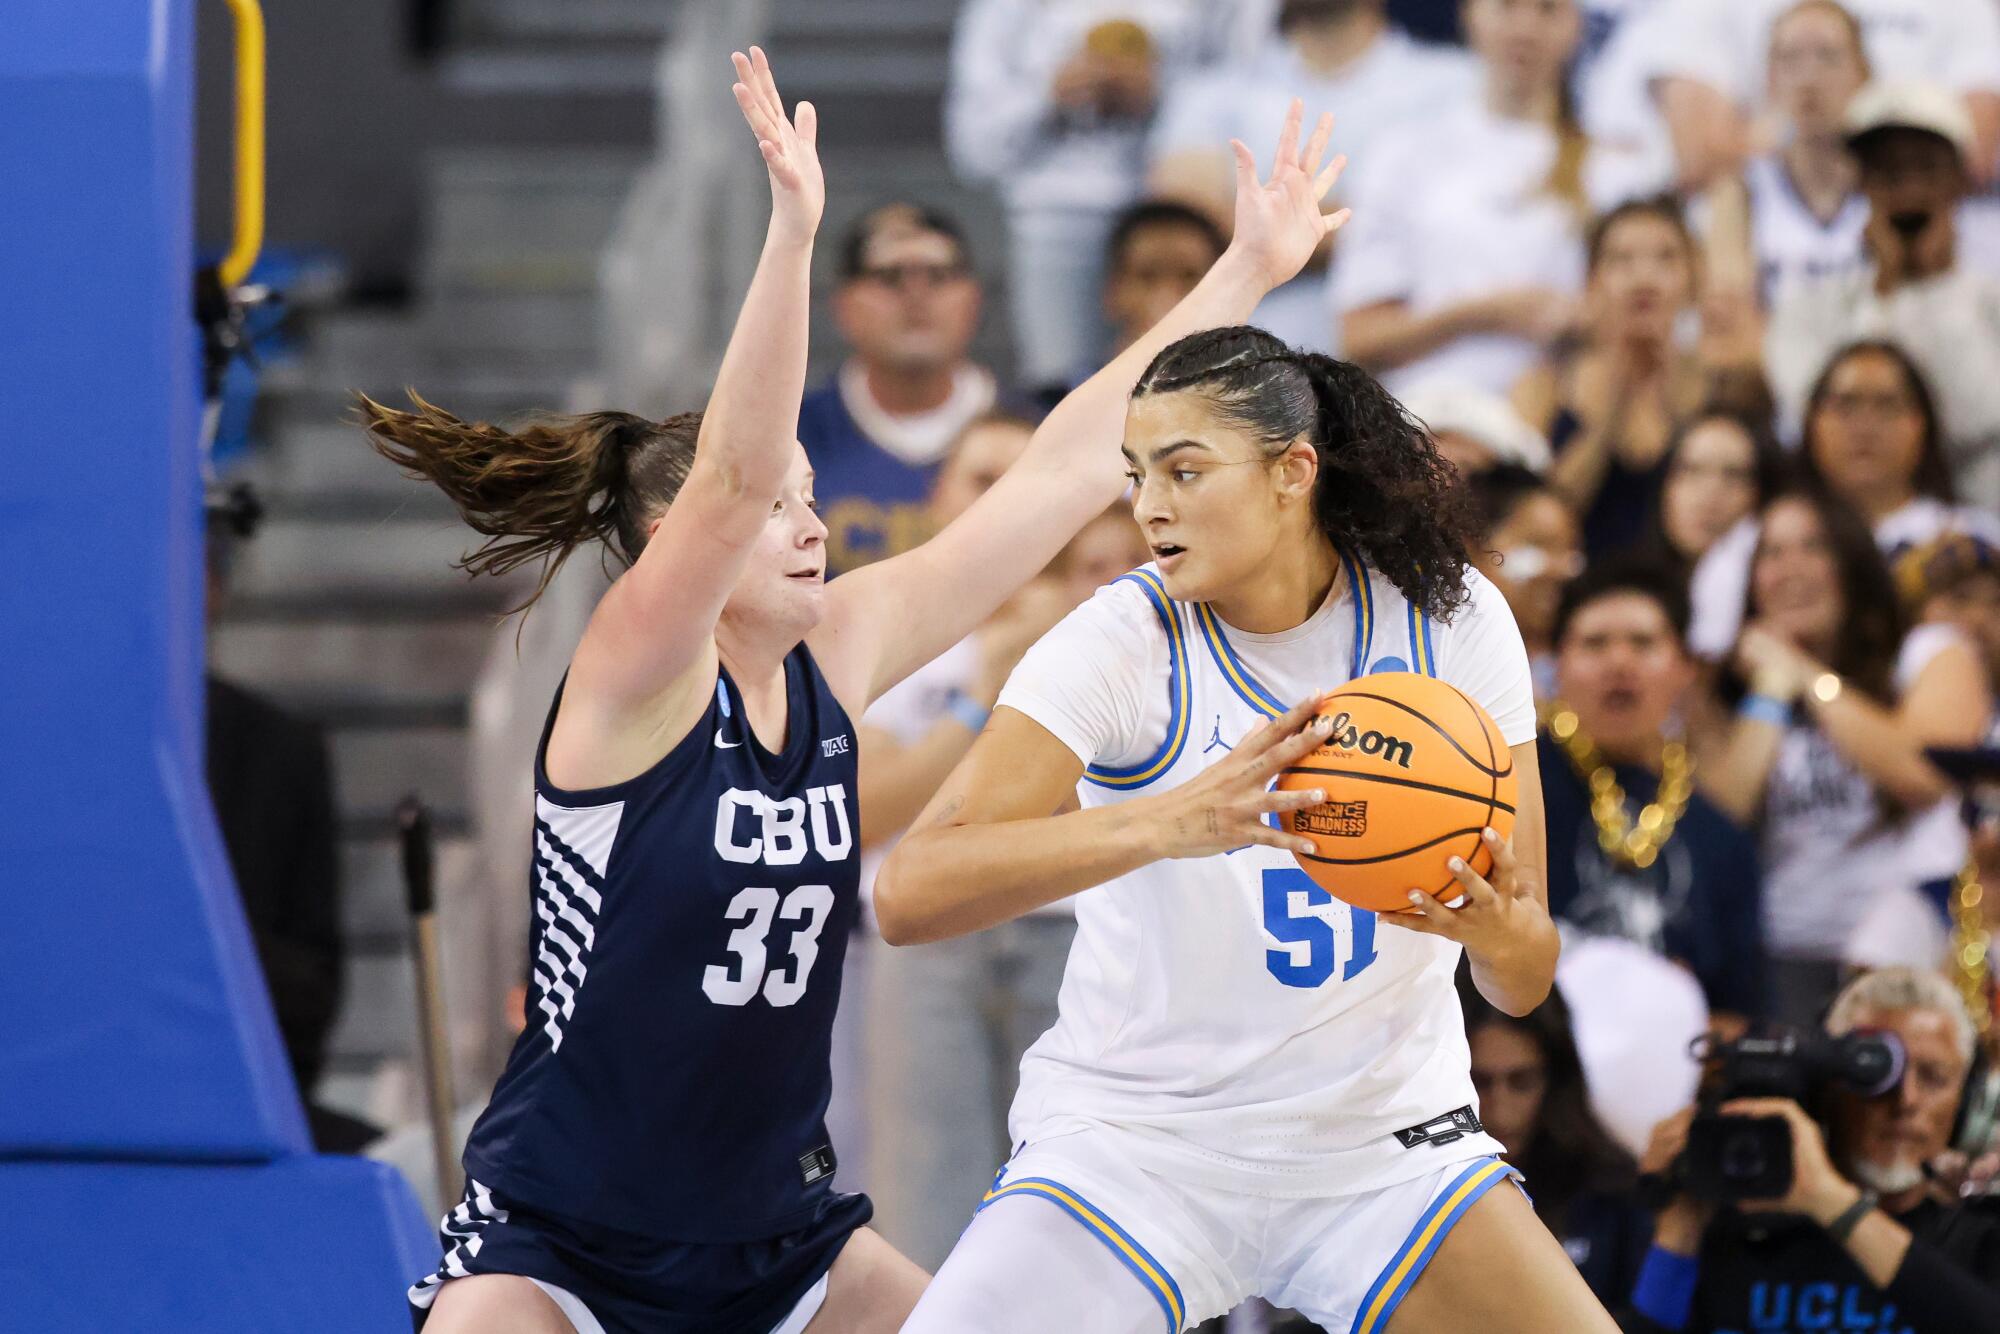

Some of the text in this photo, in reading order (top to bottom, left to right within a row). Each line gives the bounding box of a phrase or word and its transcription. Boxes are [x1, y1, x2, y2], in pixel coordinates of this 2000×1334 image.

[714, 783, 852, 865] CBU
[1310, 815, 1366, 833] MADNESS
[702, 885, 835, 1008] 33
[1262, 868, 1379, 988] 51
